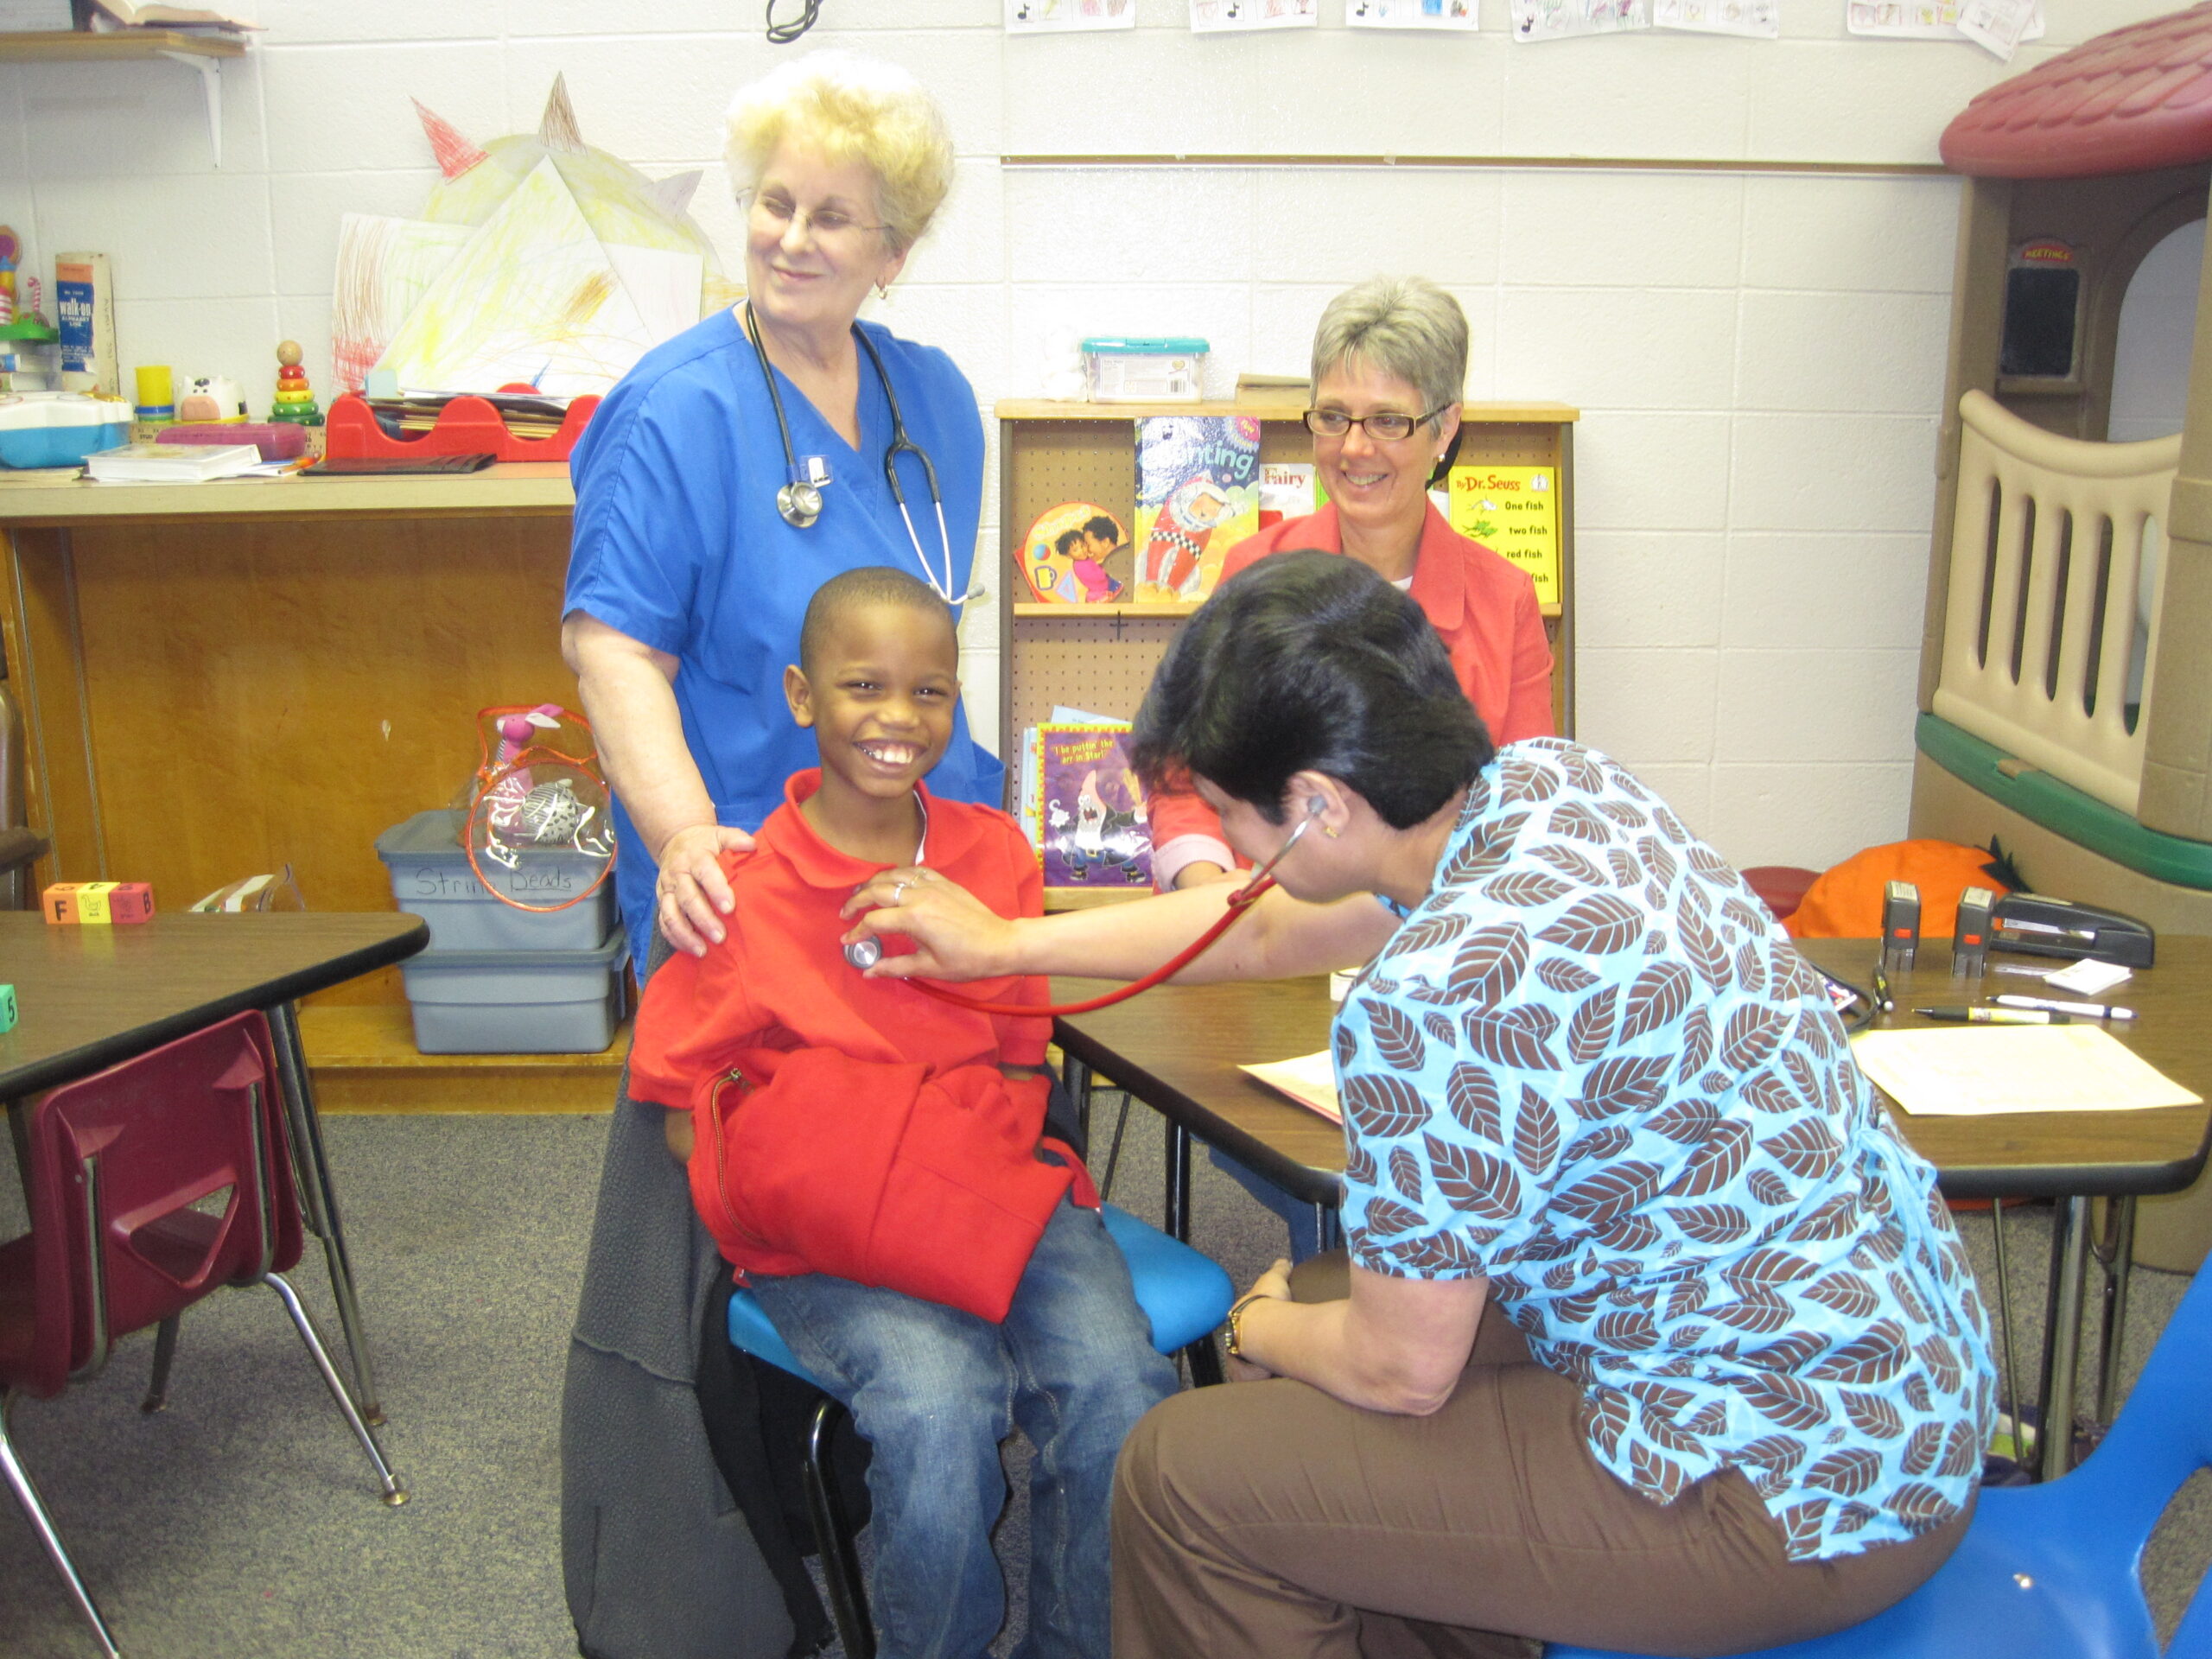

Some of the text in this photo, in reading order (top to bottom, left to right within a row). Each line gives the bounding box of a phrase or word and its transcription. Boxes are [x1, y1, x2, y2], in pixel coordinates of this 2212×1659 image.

[60, 297, 91, 316] walk-on
[1263, 467, 1306, 489] Fairy
[1456, 474, 1521, 491] By Dr. Seuss
[1525, 501, 1544, 510] fish
[1510, 525, 1548, 535] two fish
[1506, 549, 1542, 558] red fish
[1101, 739, 1114, 747] the
[416, 867, 496, 896] Strin
[54, 900, 67, 921] F
[143, 891, 151, 914] B
